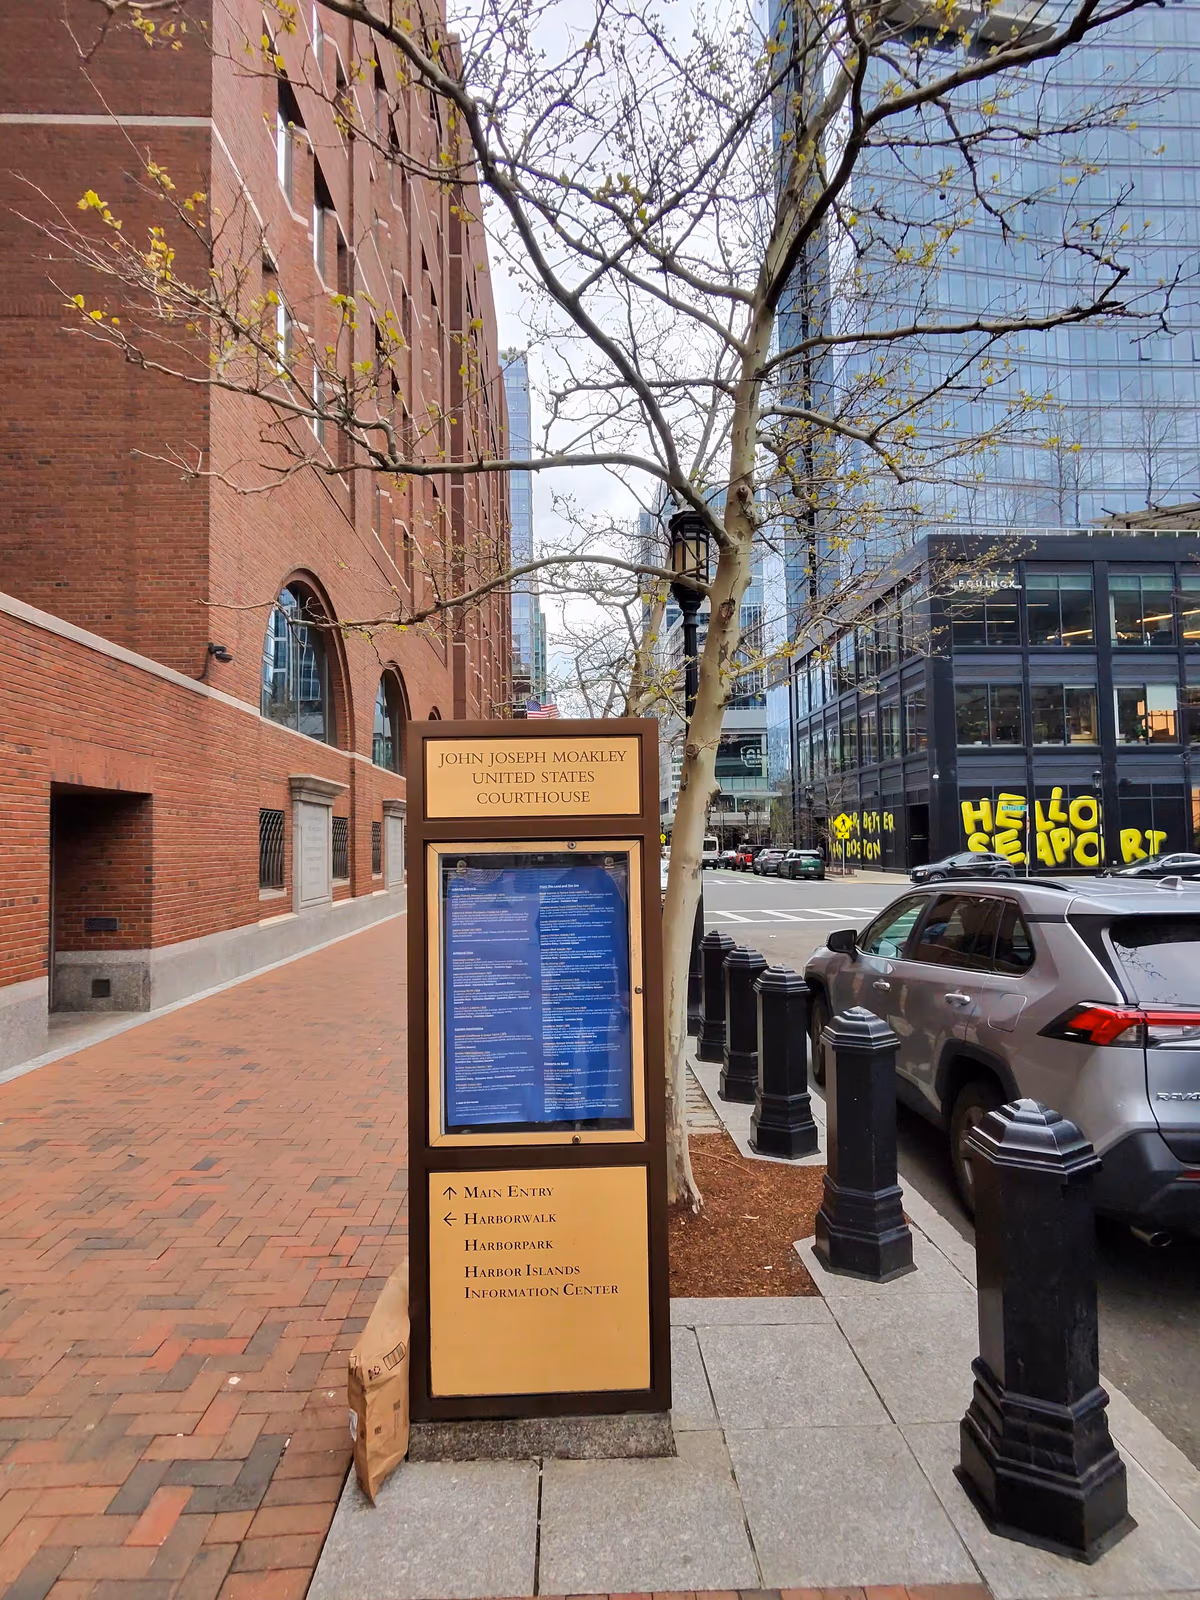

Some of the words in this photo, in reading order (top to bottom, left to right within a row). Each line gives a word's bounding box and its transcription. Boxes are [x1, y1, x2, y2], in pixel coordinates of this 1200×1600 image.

[438, 752, 484, 768] JOHN
[488, 752, 546, 768] JOSEPH
[552, 750, 627, 763] MOAKLEY
[472, 772, 535, 784] UNITED
[541, 771, 595, 783] STATES
[476, 791, 591, 804] COURTHOUSE
[960, 786, 1099, 835] HELLO
[846, 838, 881, 860] BOSTON
[464, 1186, 502, 1199] MAIN
[507, 1185, 554, 1198] ENTRY
[464, 1213, 557, 1225] HARBORWALK
[464, 1239, 554, 1251] HARBORPARK
[464, 1265, 522, 1278] HARBOR
[525, 1264, 581, 1276] ISLANDS
[464, 1286, 560, 1299] INFORMATION
[562, 1283, 620, 1296] CENTER
